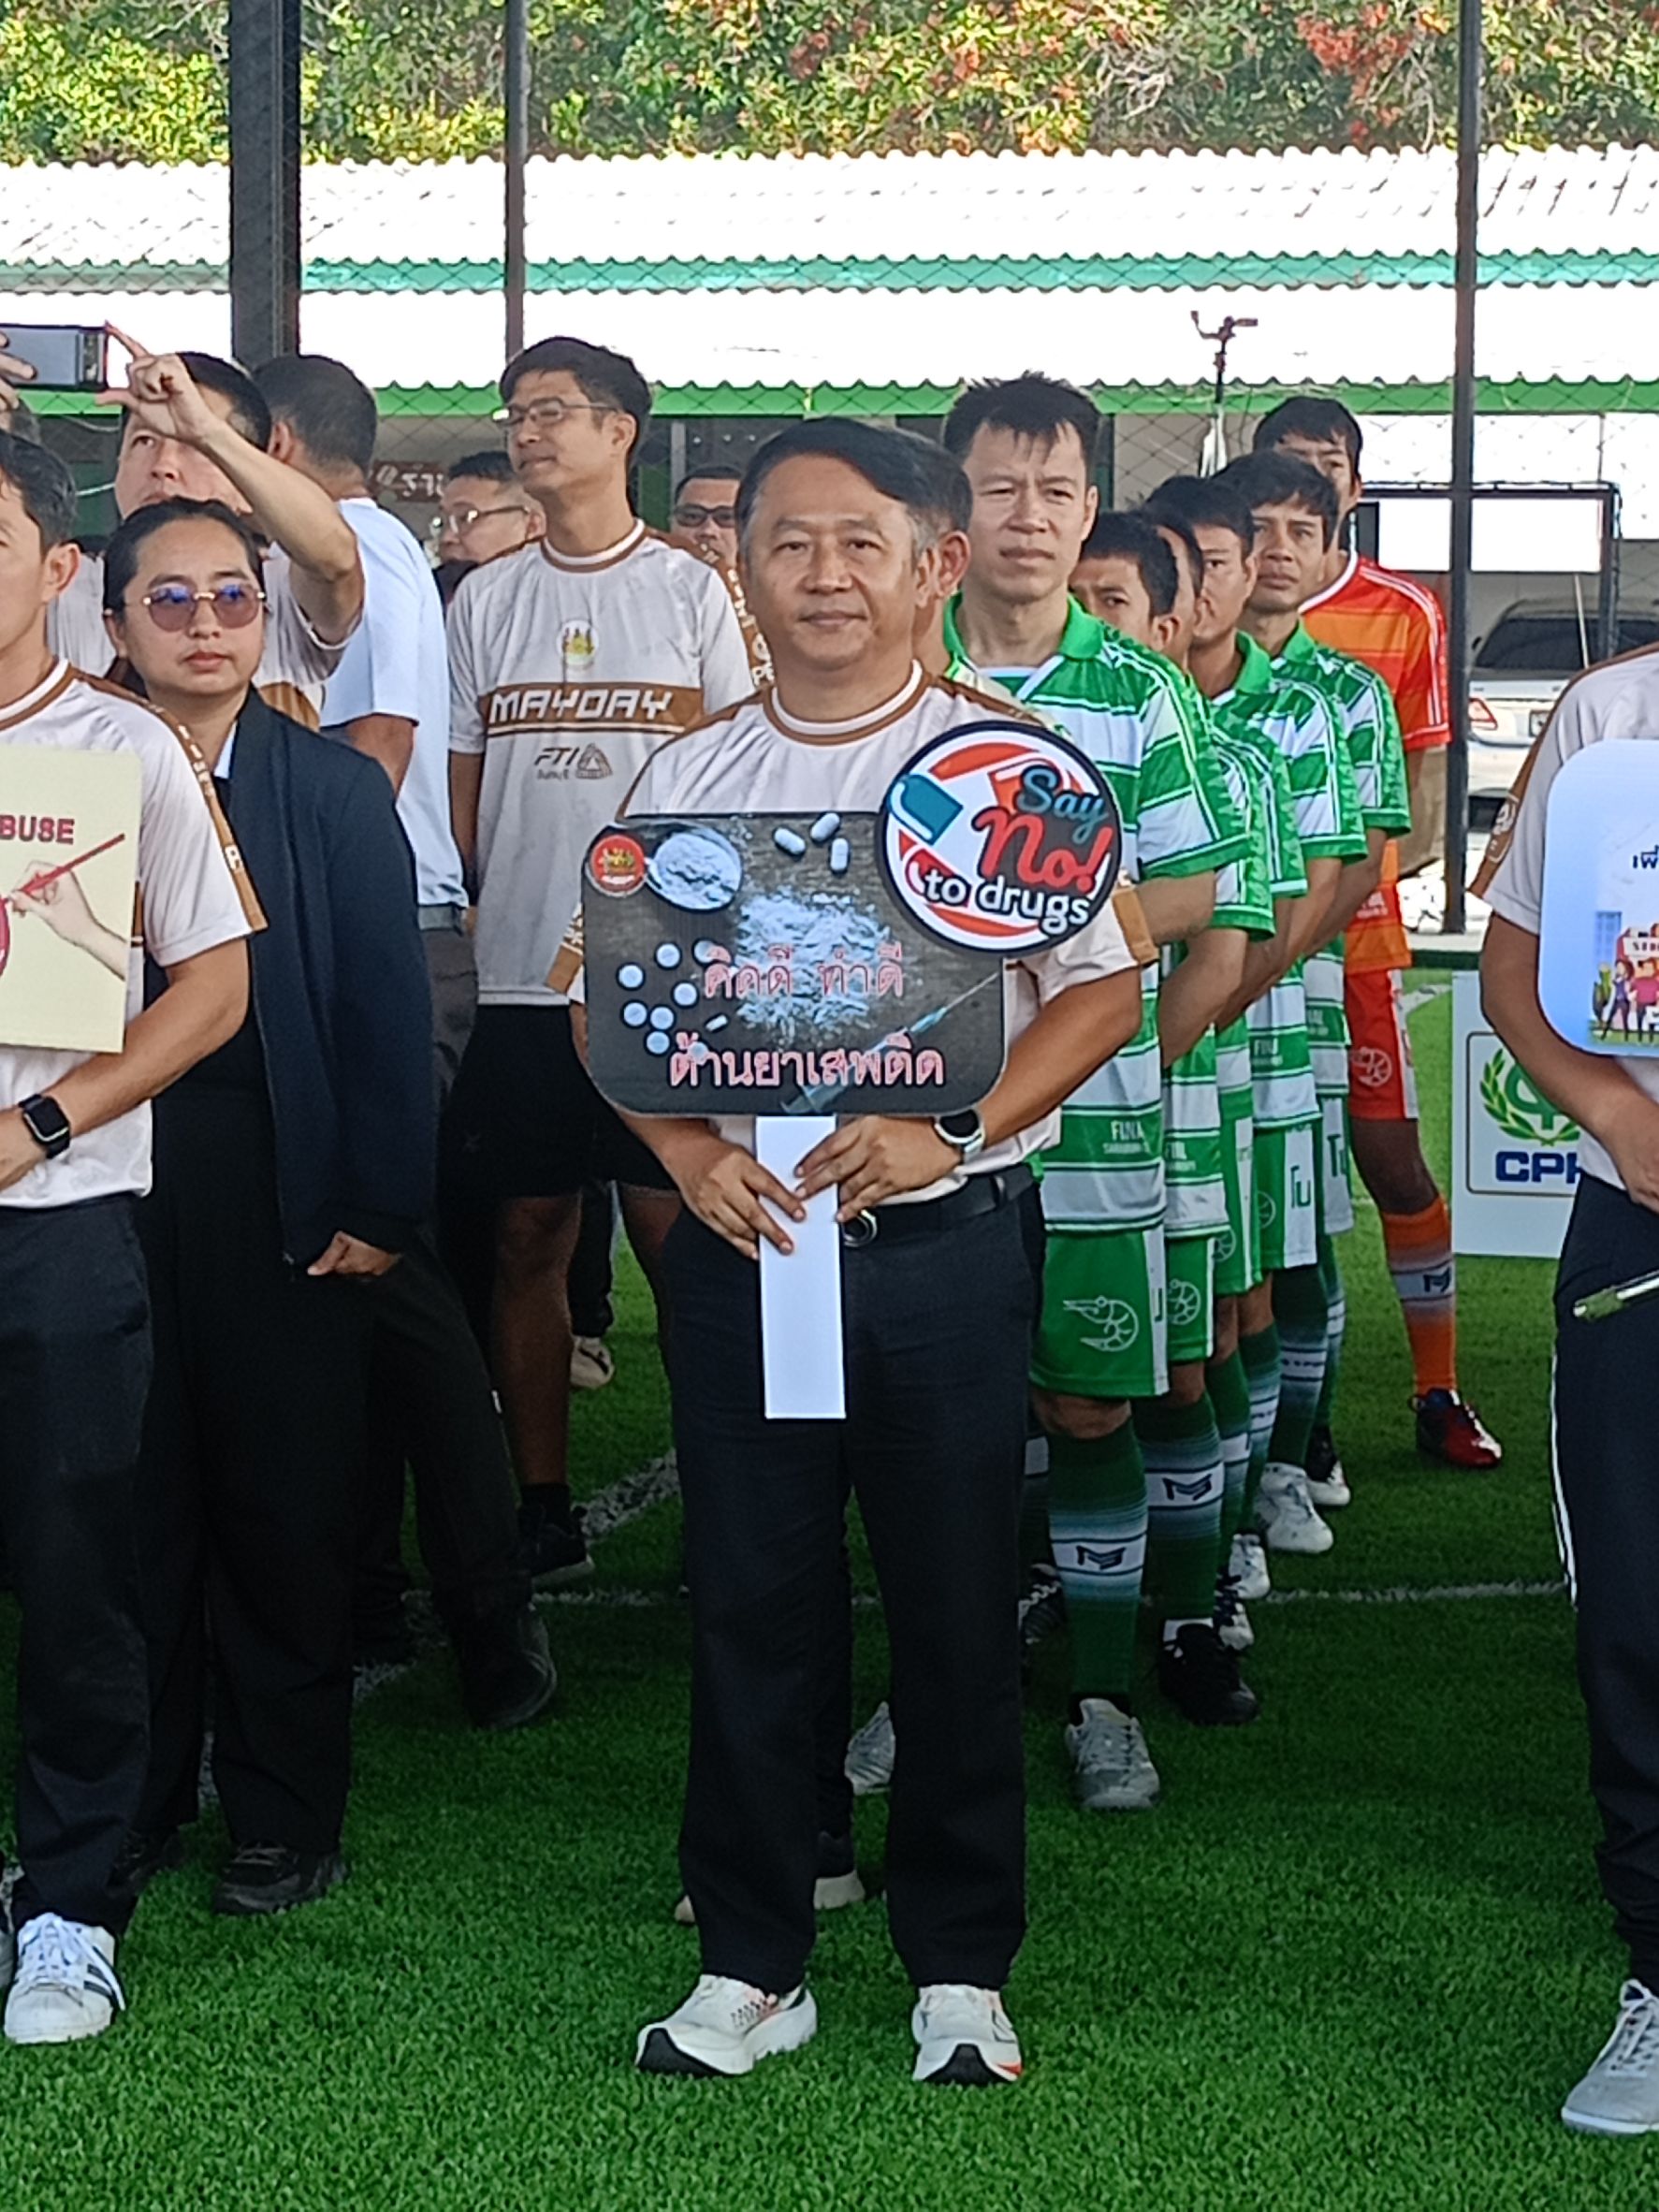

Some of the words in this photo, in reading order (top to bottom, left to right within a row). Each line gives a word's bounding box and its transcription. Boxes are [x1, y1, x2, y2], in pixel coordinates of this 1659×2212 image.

[488, 689, 674, 724] MAYDAY
[1016, 766, 1109, 845] Say
[924, 868, 968, 903] to
[978, 874, 1090, 935] drugs
[669, 1031, 945, 1087] ต้านยาเสพติด
